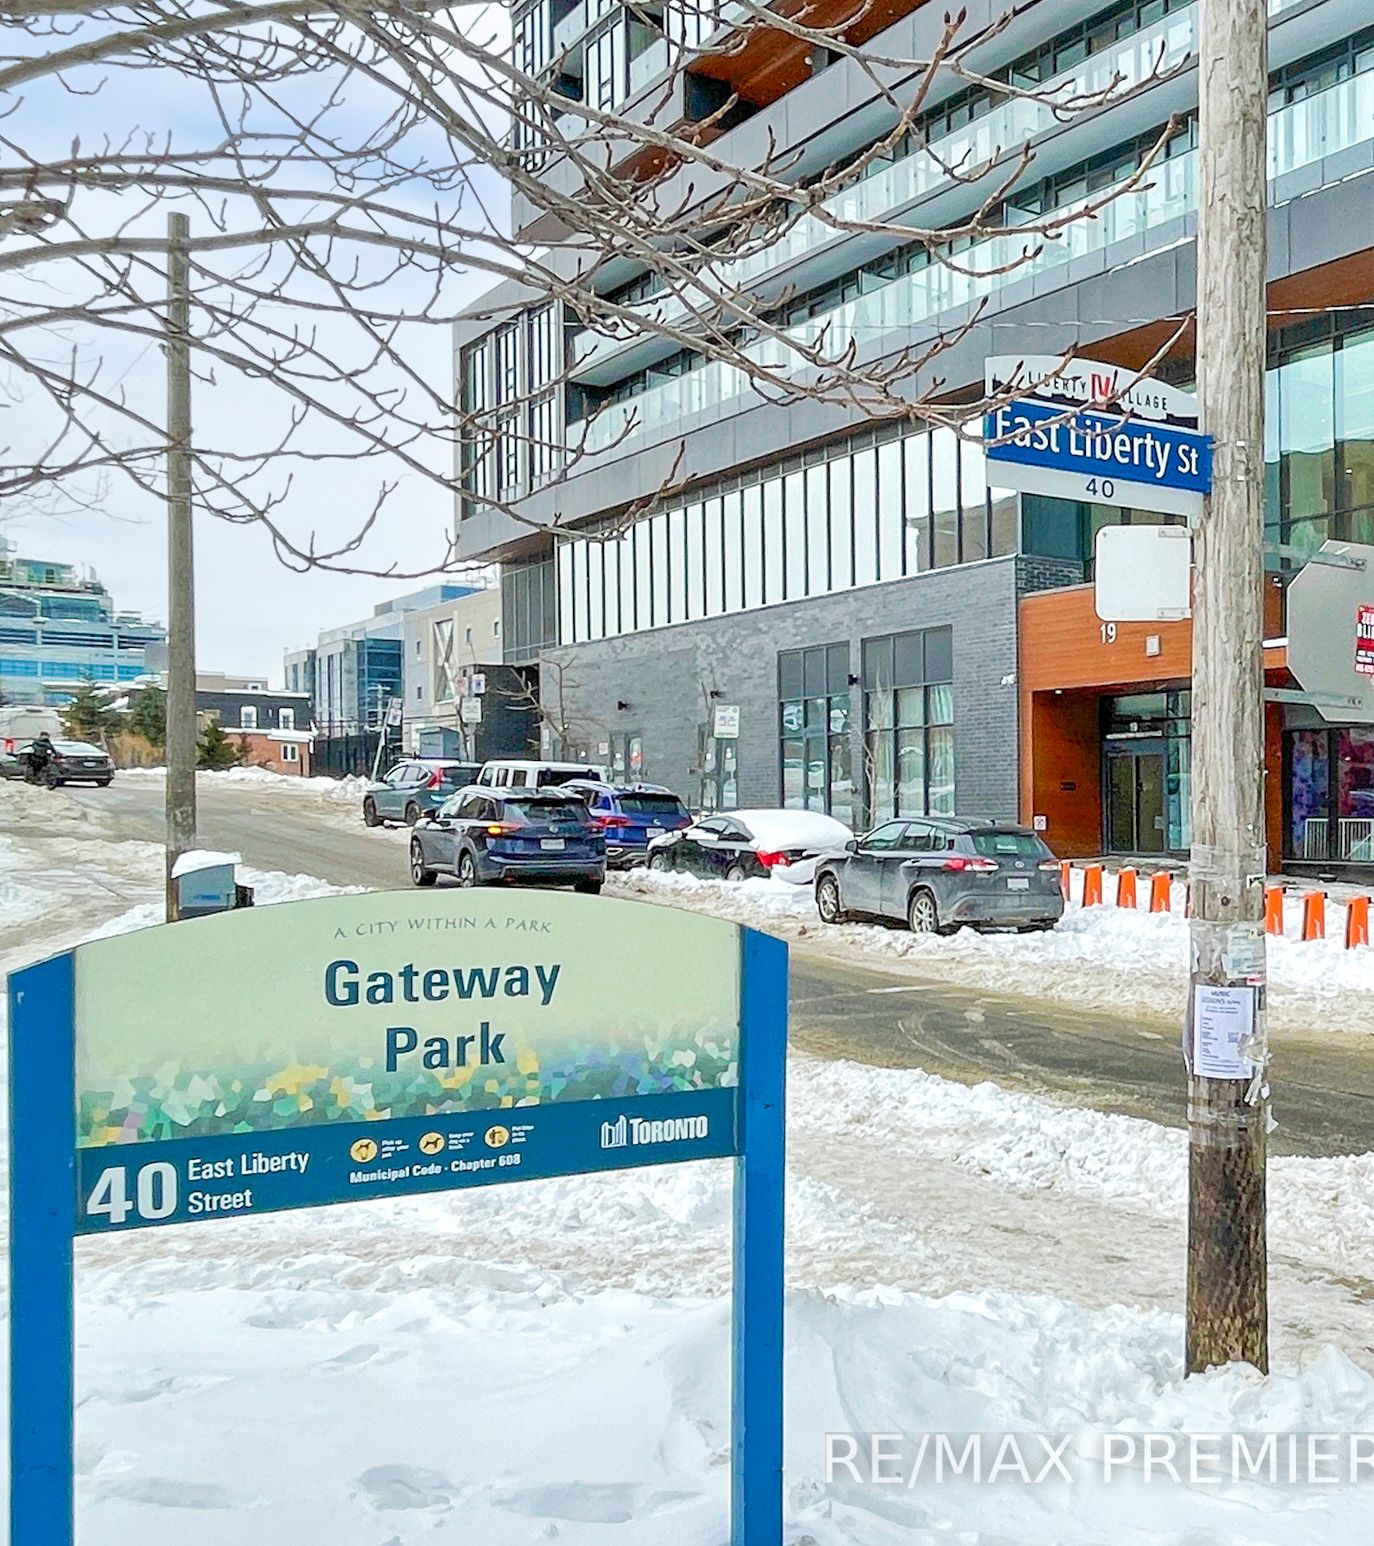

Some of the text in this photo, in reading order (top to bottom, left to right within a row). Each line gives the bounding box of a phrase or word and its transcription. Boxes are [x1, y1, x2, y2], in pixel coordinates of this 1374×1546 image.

[996, 405, 1199, 479] East Liberty St
[1085, 477, 1115, 499] 40
[1099, 622, 1117, 645] 19
[334, 916, 553, 940] A CITY WITHIN A PARK
[324, 959, 562, 1008] Gateway
[385, 1021, 507, 1074] Park
[628, 1114, 709, 1146] TORONTO
[187, 1151, 310, 1182] East Liberty
[349, 1153, 522, 1184] Municipal Code Chapter 608
[86, 1160, 178, 1225] 40
[187, 1188, 253, 1215] Street
